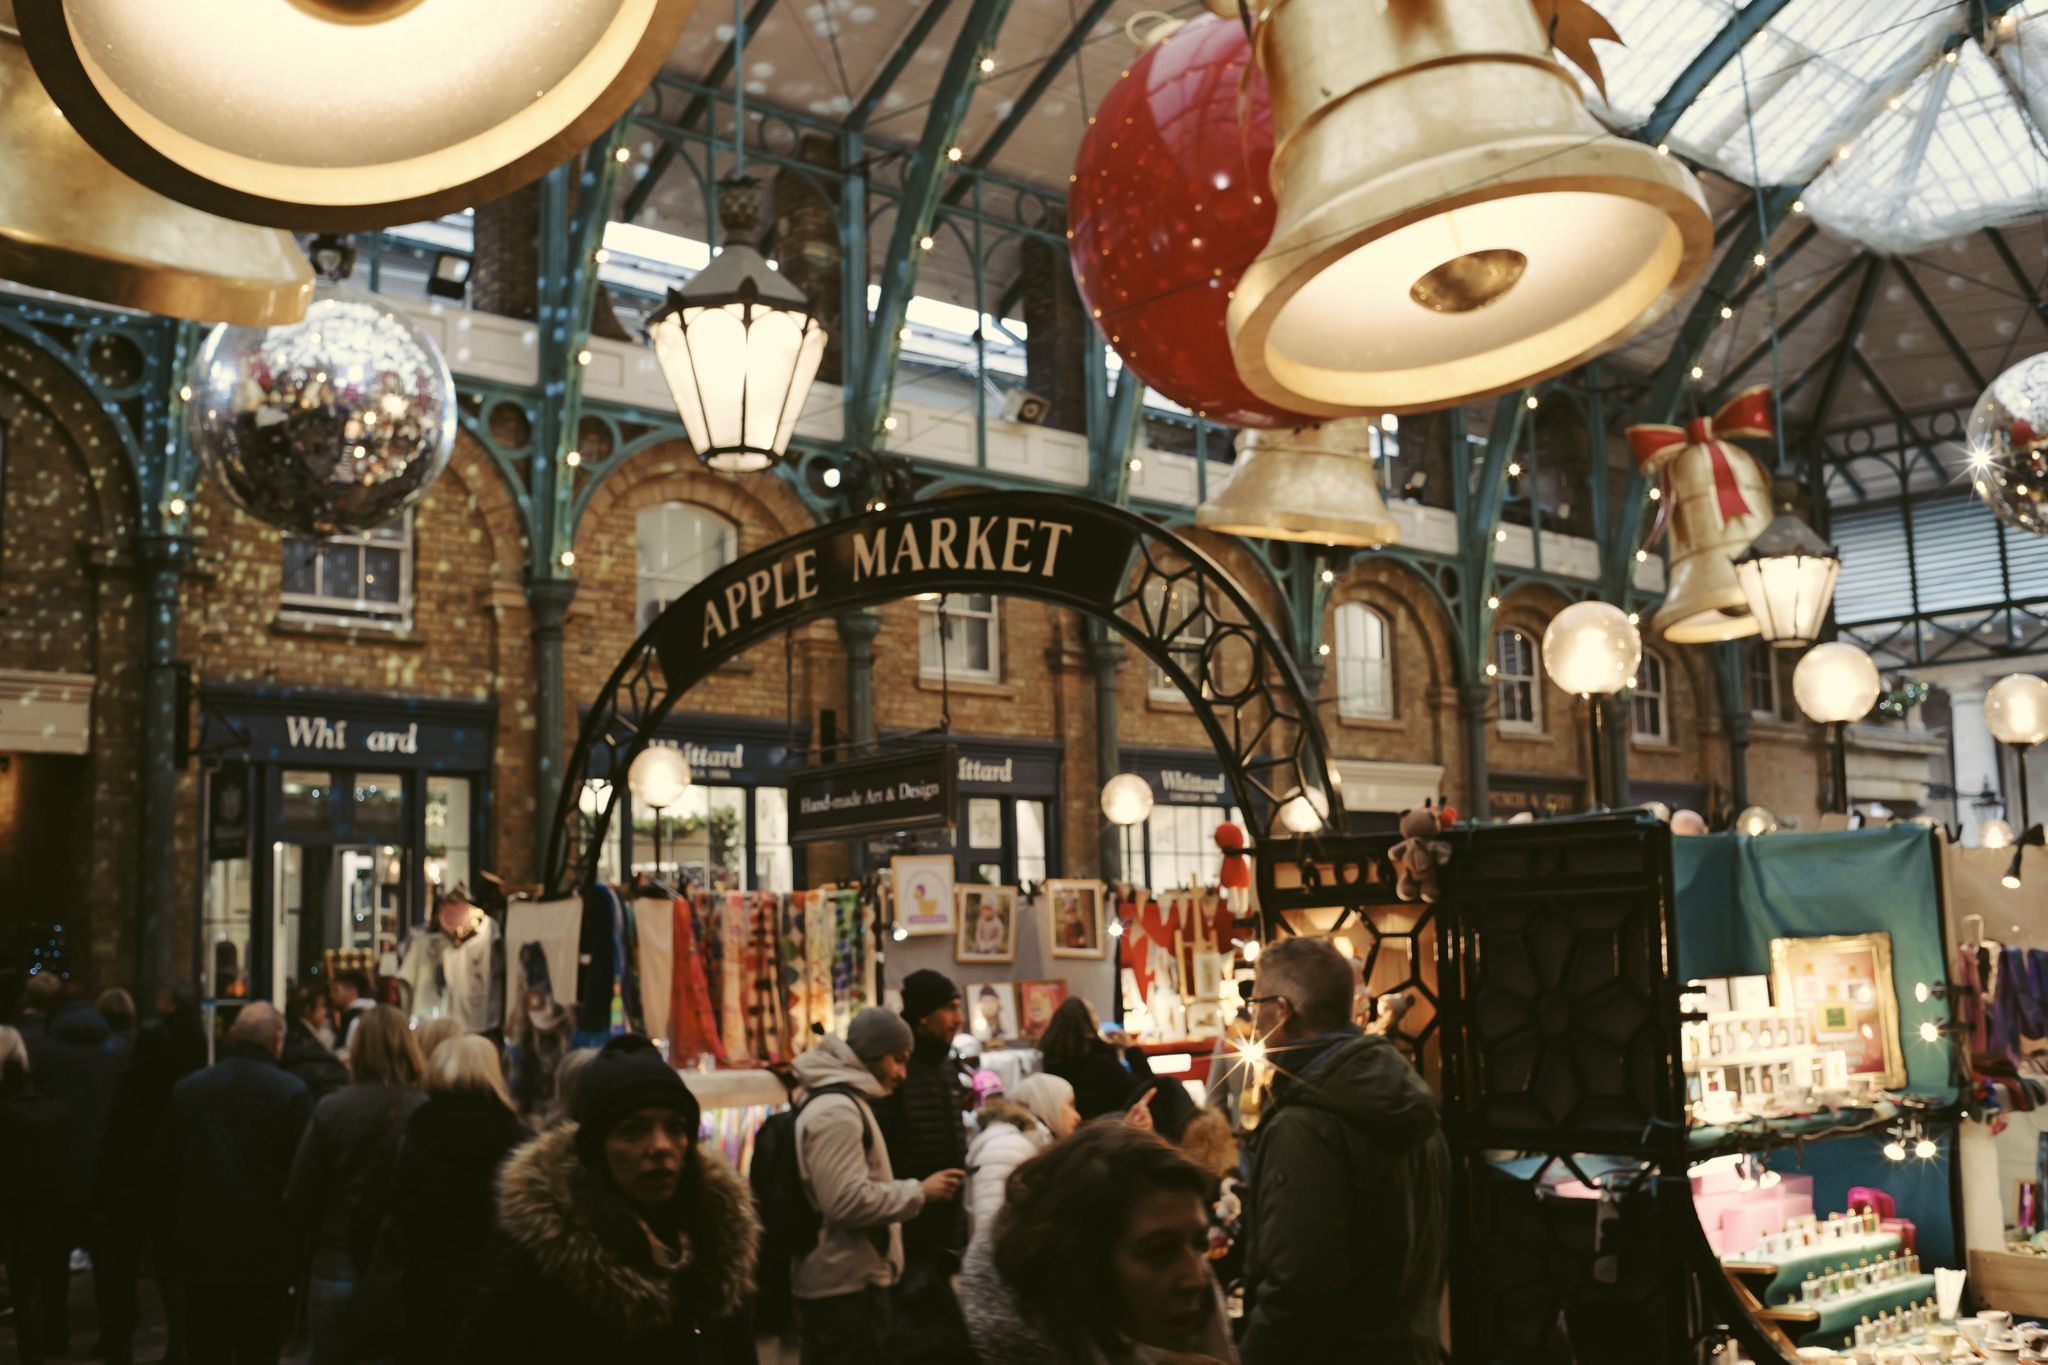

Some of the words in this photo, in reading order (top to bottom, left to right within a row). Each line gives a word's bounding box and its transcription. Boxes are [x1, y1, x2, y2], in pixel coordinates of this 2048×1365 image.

[702, 549, 819, 648] APPLE
[852, 515, 1073, 582] MARKET
[648, 738, 744, 768] ittard
[957, 756, 1013, 782] ittard
[864, 788, 883, 804] Art
[885, 786, 896, 801] &
[899, 779, 940, 801] Design
